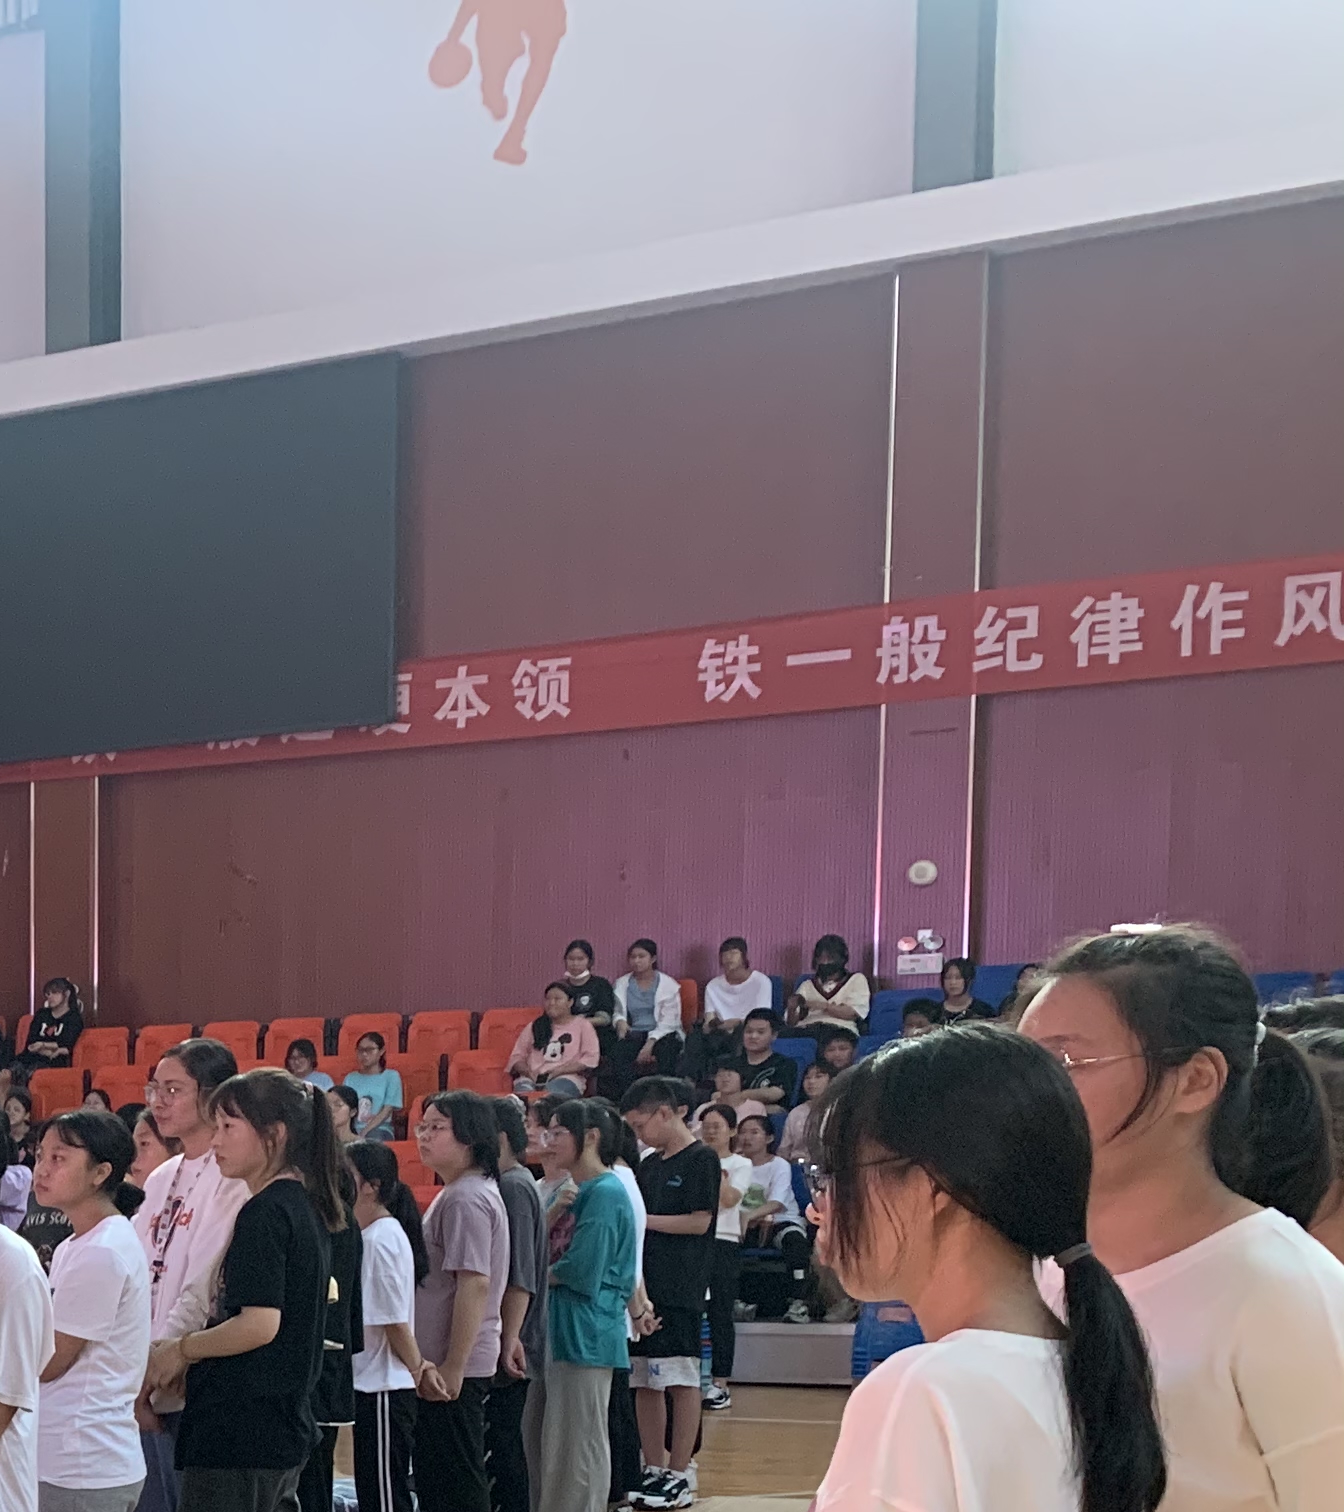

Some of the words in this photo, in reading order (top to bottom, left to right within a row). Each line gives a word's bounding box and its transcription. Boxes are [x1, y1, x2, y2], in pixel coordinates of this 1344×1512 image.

[699, 570, 1344, 703] 铁一般纪律作风
